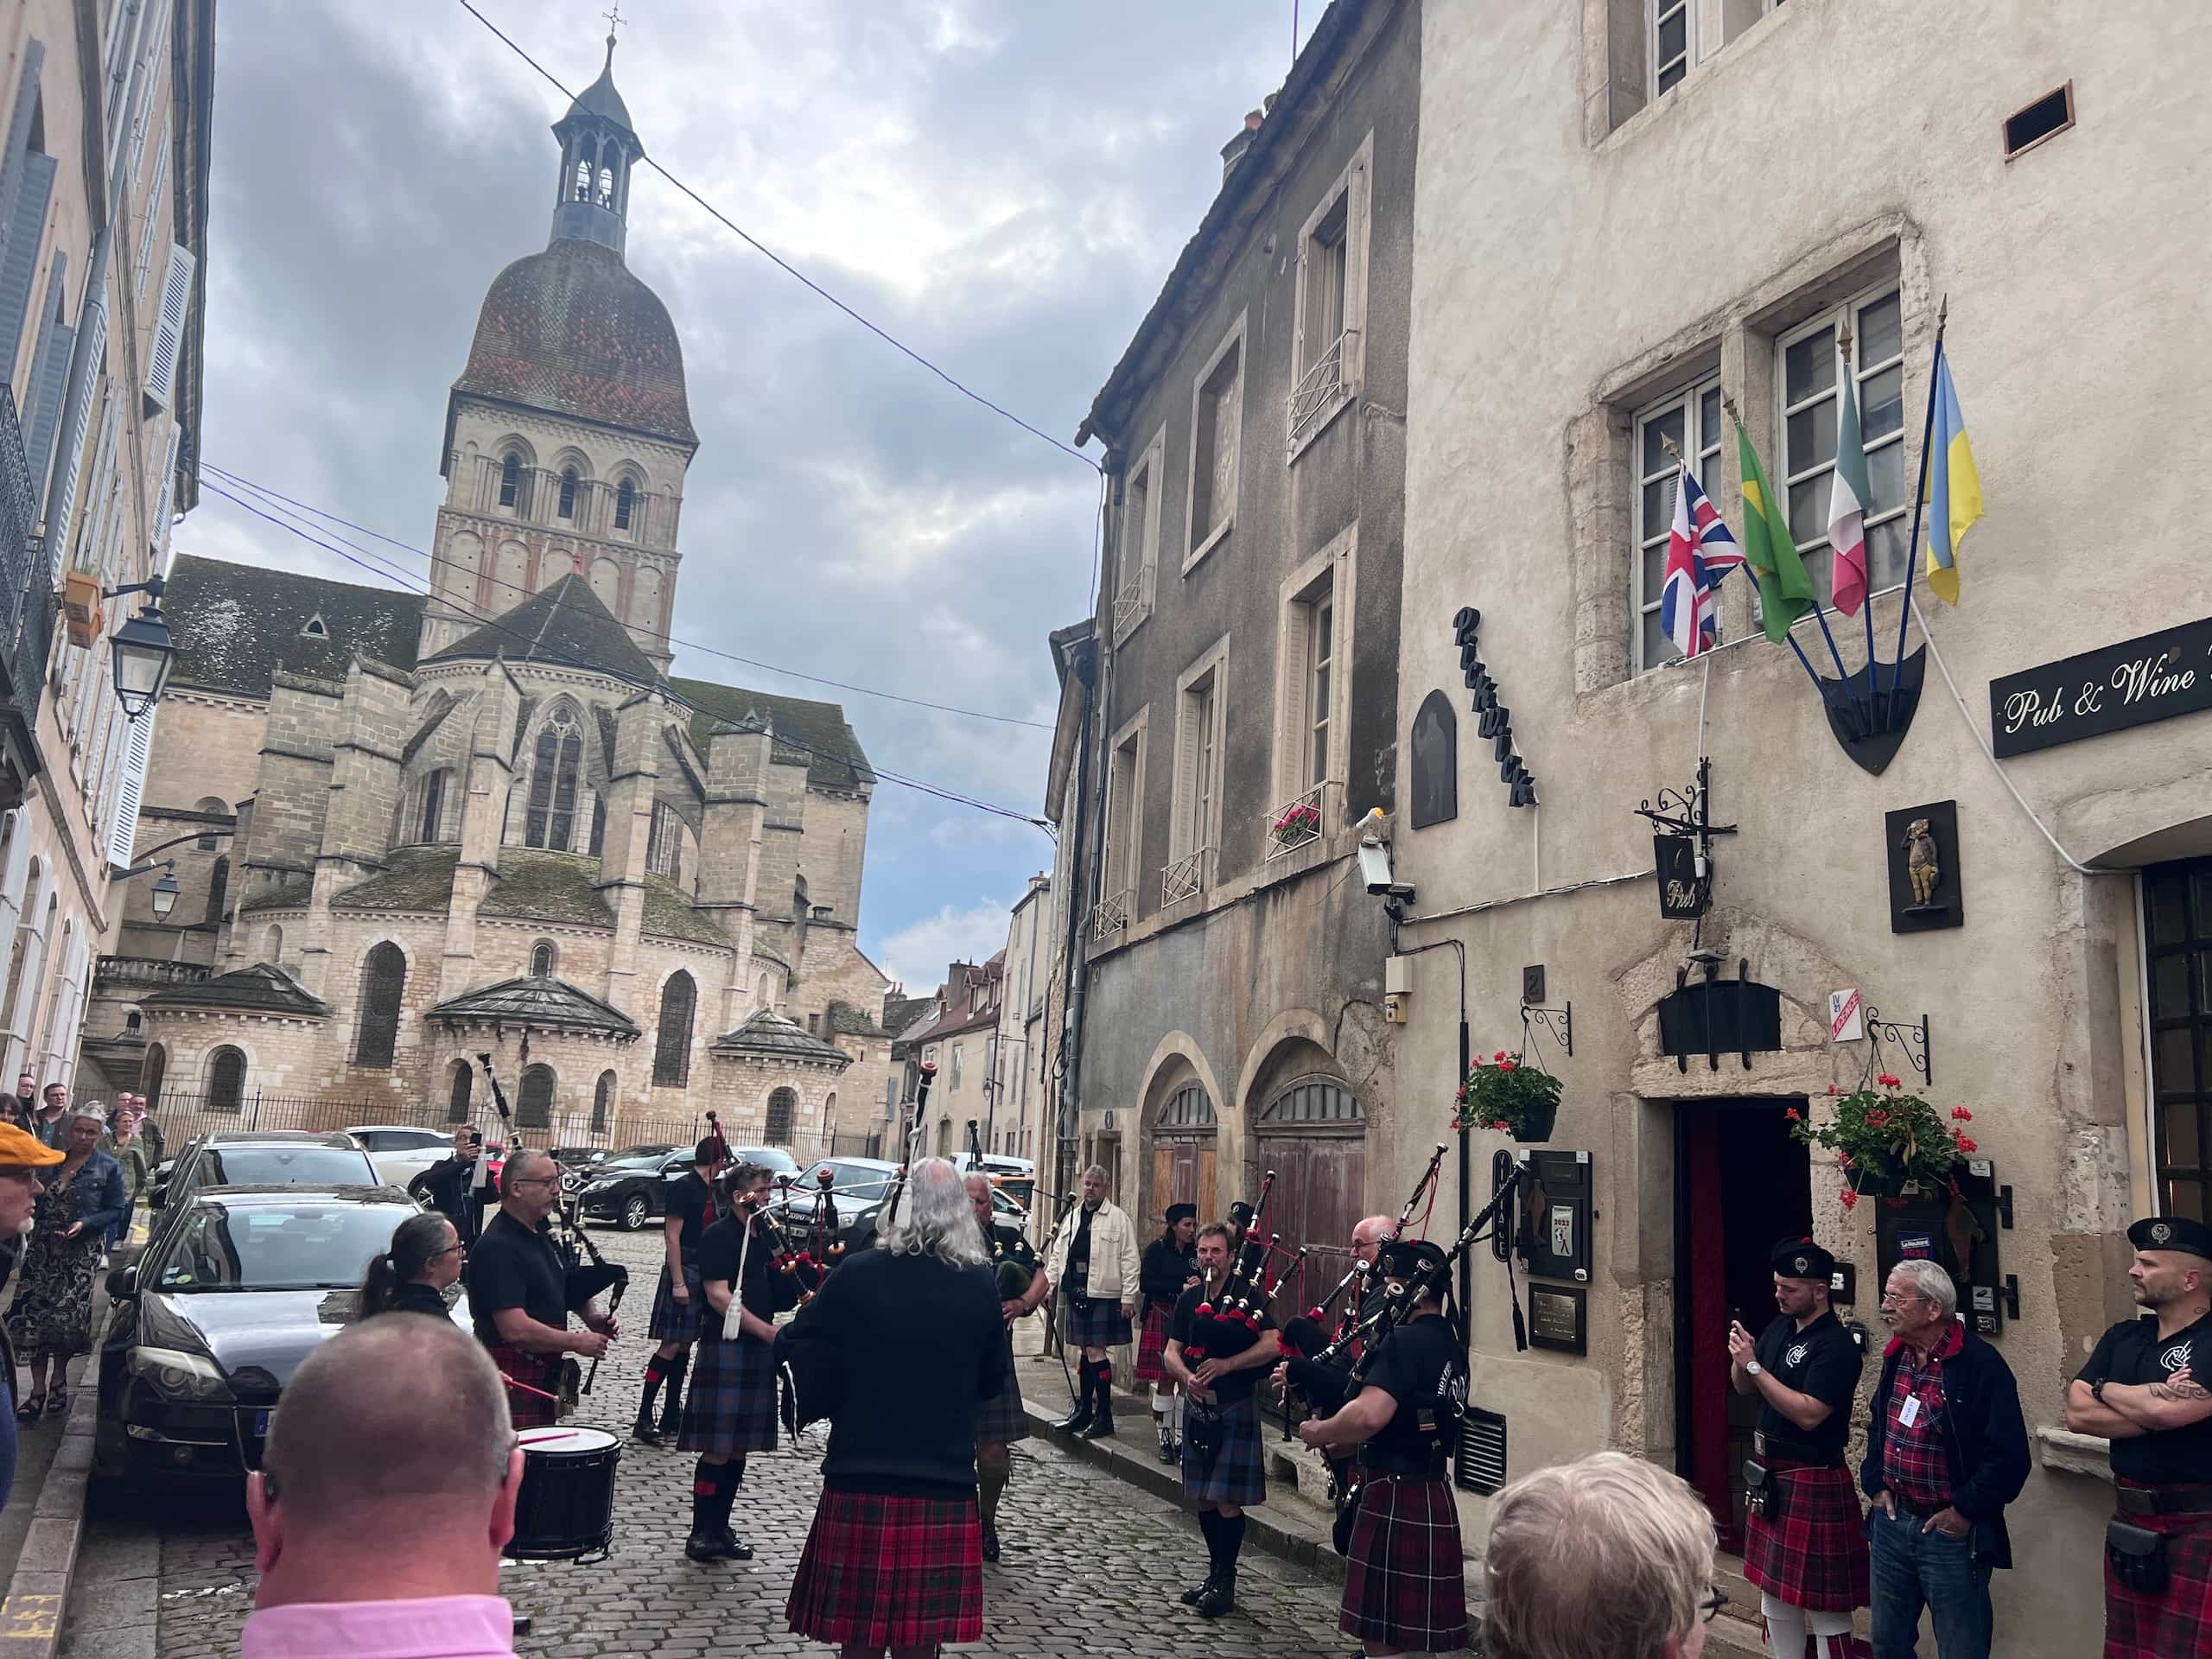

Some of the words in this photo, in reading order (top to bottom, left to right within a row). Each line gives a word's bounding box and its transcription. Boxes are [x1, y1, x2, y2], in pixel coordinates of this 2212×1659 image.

[2004, 687, 2064, 733] Pub
[2074, 682, 2103, 715] &
[2111, 653, 2196, 705] Wine
[1666, 880, 1695, 909] Pub
